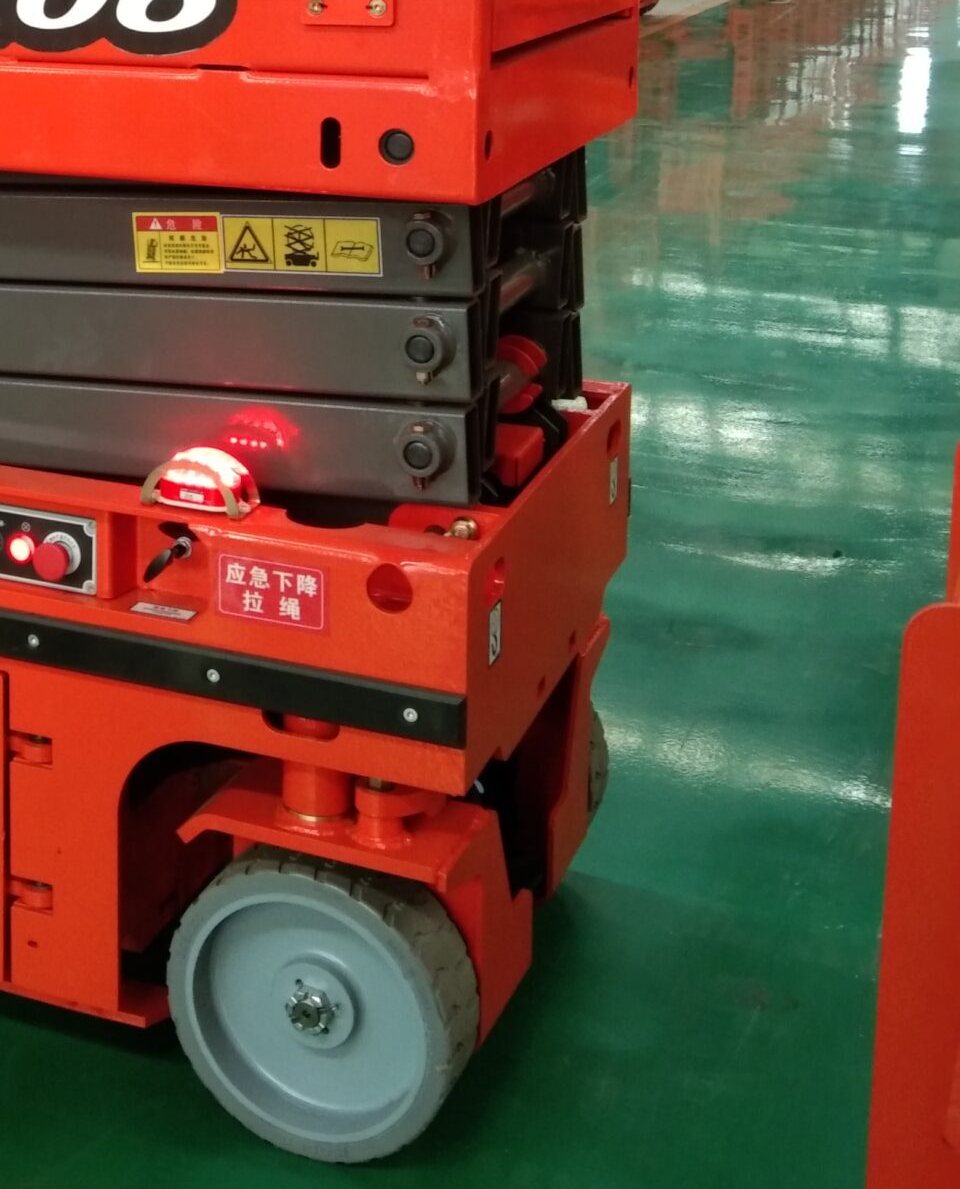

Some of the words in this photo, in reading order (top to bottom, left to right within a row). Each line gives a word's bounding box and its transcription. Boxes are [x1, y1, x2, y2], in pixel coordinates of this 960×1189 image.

[225, 563, 317, 597] 应急下降
[242, 590, 300, 621] 拉绳
